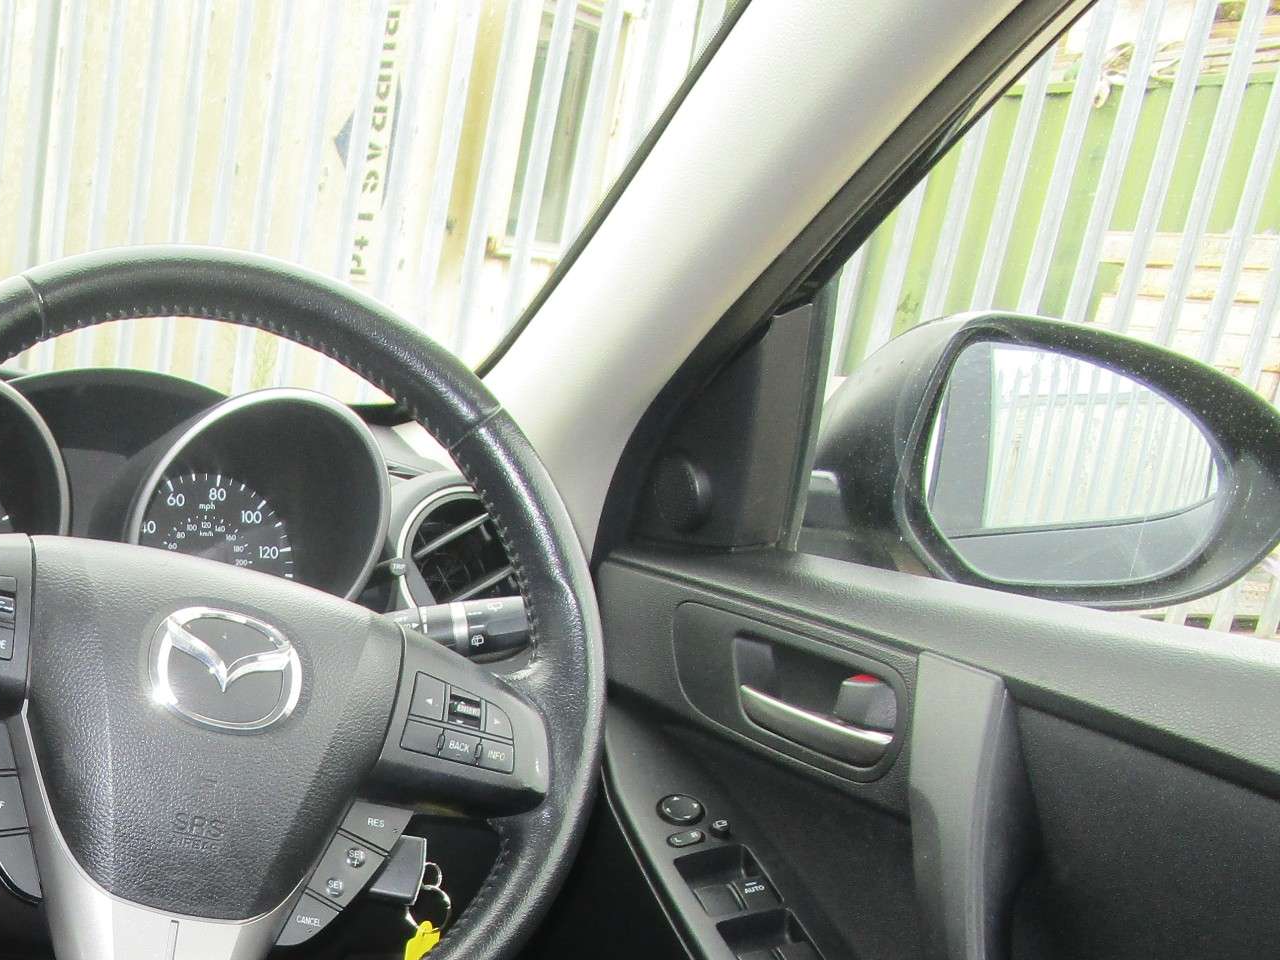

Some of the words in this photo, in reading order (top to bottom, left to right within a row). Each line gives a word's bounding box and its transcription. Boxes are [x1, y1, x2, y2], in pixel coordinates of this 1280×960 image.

[167, 493, 185, 507] 60
[208, 487, 227, 502] 80
[199, 502, 216, 511] mph
[241, 510, 262, 523] 100
[201, 521, 212, 529] 120
[176, 531, 186, 539] 80
[167, 542, 178, 550] 60
[259, 546, 279, 559] 120
[448, 739, 470, 753] BACK
[487, 749, 506, 761] INFO
[367, 817, 385, 828] RES
[744, 884, 766, 894] AUTO
[296, 915, 321, 928] CANCEL
